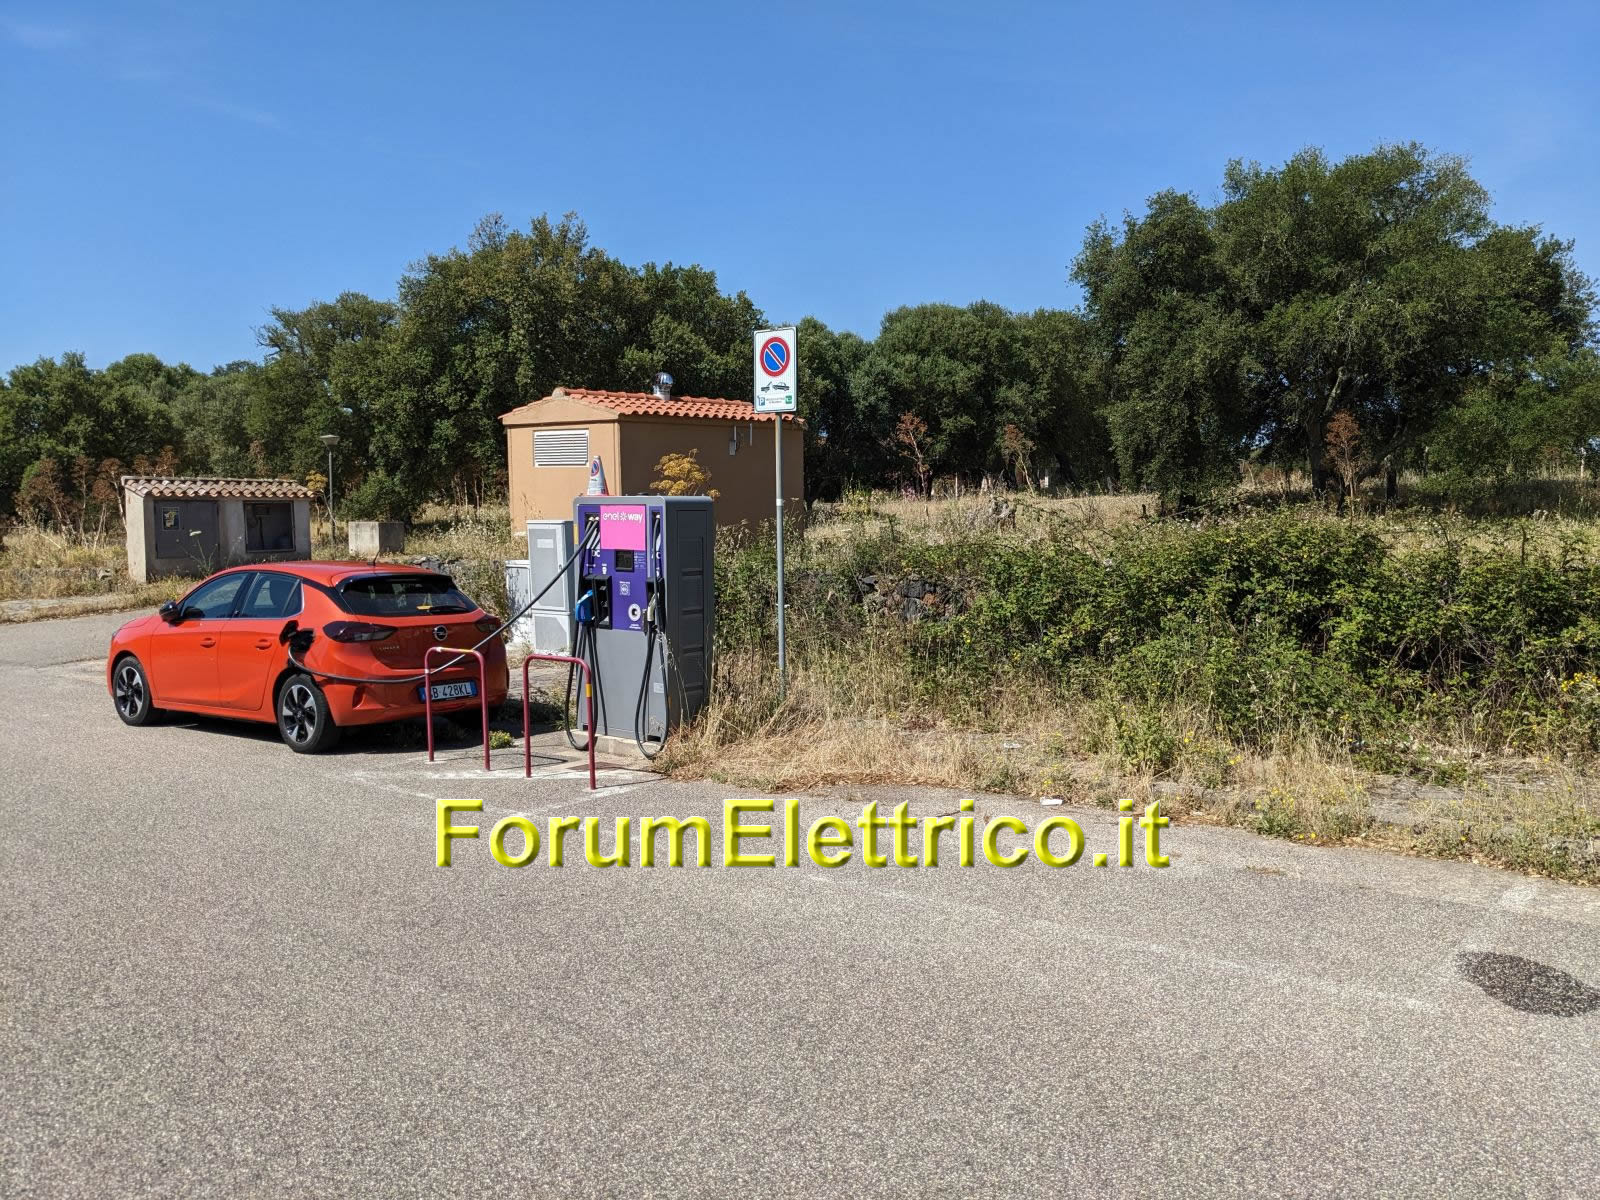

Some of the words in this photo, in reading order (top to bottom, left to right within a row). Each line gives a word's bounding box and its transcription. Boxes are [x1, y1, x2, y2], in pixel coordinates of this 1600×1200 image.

[602, 512, 619, 521] enel
[628, 513, 642, 523] way
[442, 684, 471, 697] 428KL
